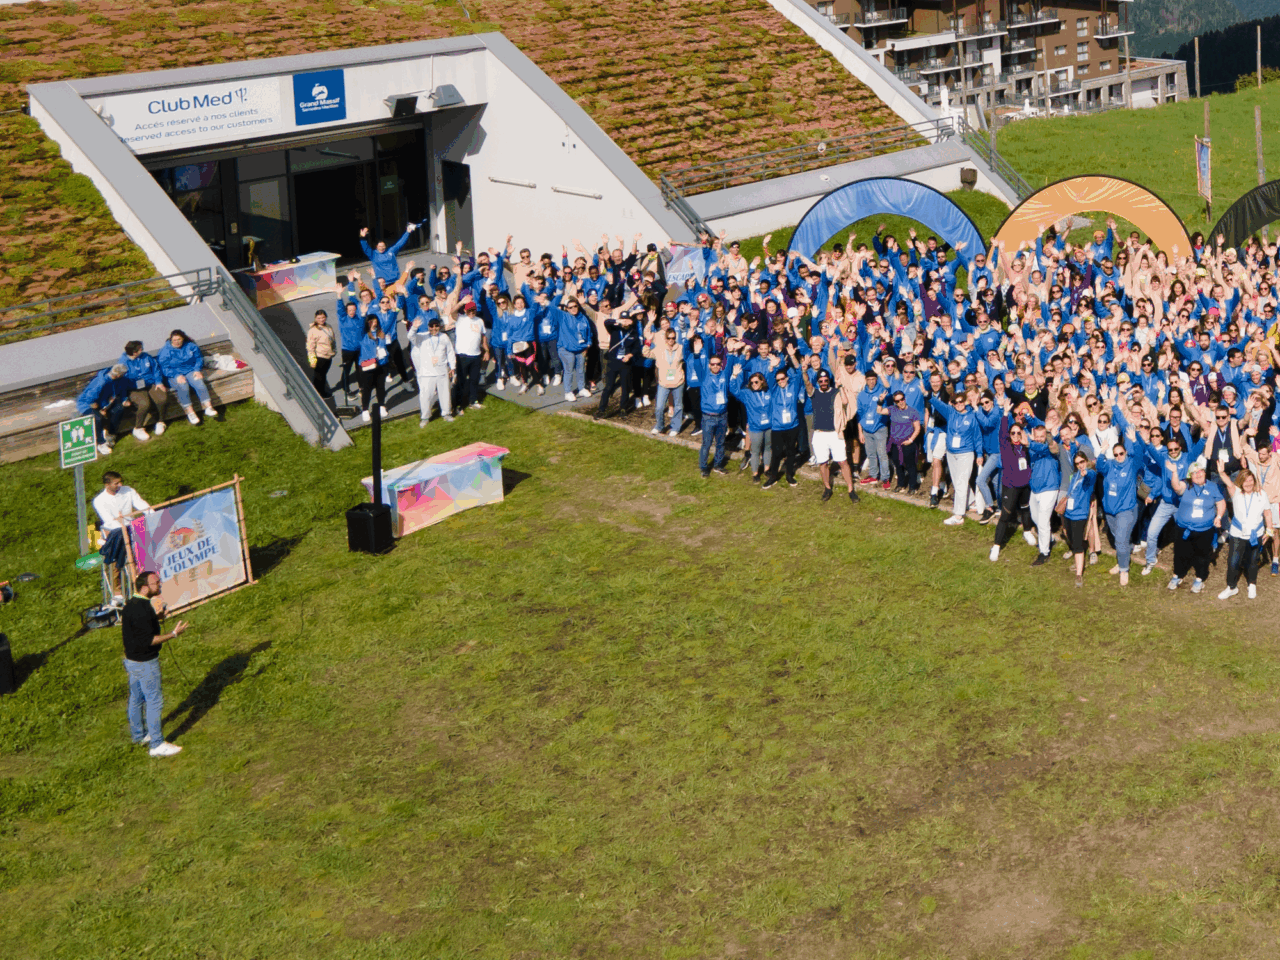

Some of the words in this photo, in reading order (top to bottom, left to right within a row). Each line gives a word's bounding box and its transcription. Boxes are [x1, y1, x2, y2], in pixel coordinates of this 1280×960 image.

[148, 97, 191, 114] Club
[193, 91, 232, 108] Med
[211, 113, 227, 121] nos
[229, 108, 259, 118] clients
[165, 128, 197, 138] access
[227, 117, 273, 129] customers
[163, 544, 219, 578] L'OLYMPE
[166, 545, 194, 566] JEUX
[197, 535, 212, 551] DE
